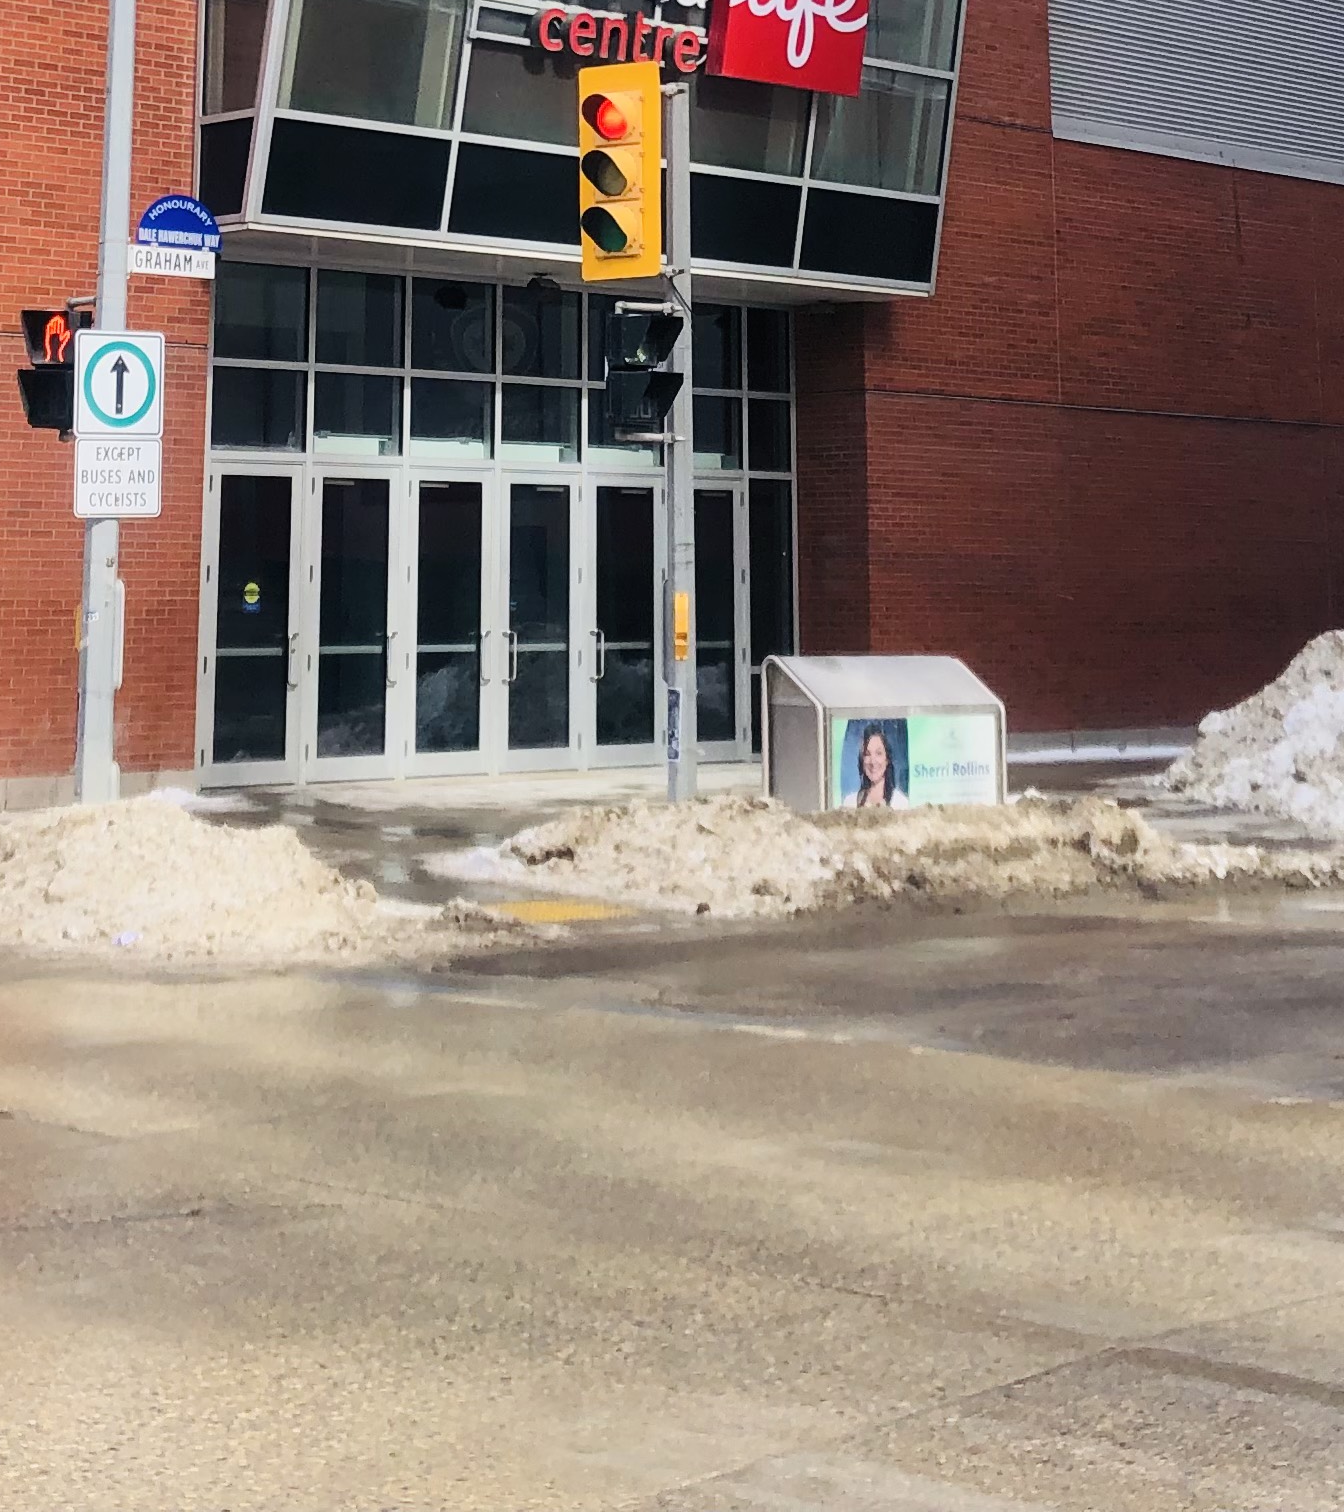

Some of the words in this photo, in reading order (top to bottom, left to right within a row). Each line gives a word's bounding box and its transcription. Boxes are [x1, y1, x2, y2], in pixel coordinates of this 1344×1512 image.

[538, 8, 701, 73] centre
[148, 199, 213, 226] HONOURARY
[138, 227, 157, 242] DALE
[203, 233, 221, 248] WAY
[135, 250, 193, 273] GRAHAM
[196, 260, 209, 270] AVE
[96, 447, 142, 461] EXCEPT
[81, 469, 122, 484] BUSES
[128, 469, 155, 484] AND
[89, 492, 147, 507] CYCLISTS
[914, 763, 949, 777] Sherri
[952, 762, 990, 776] Rollins
